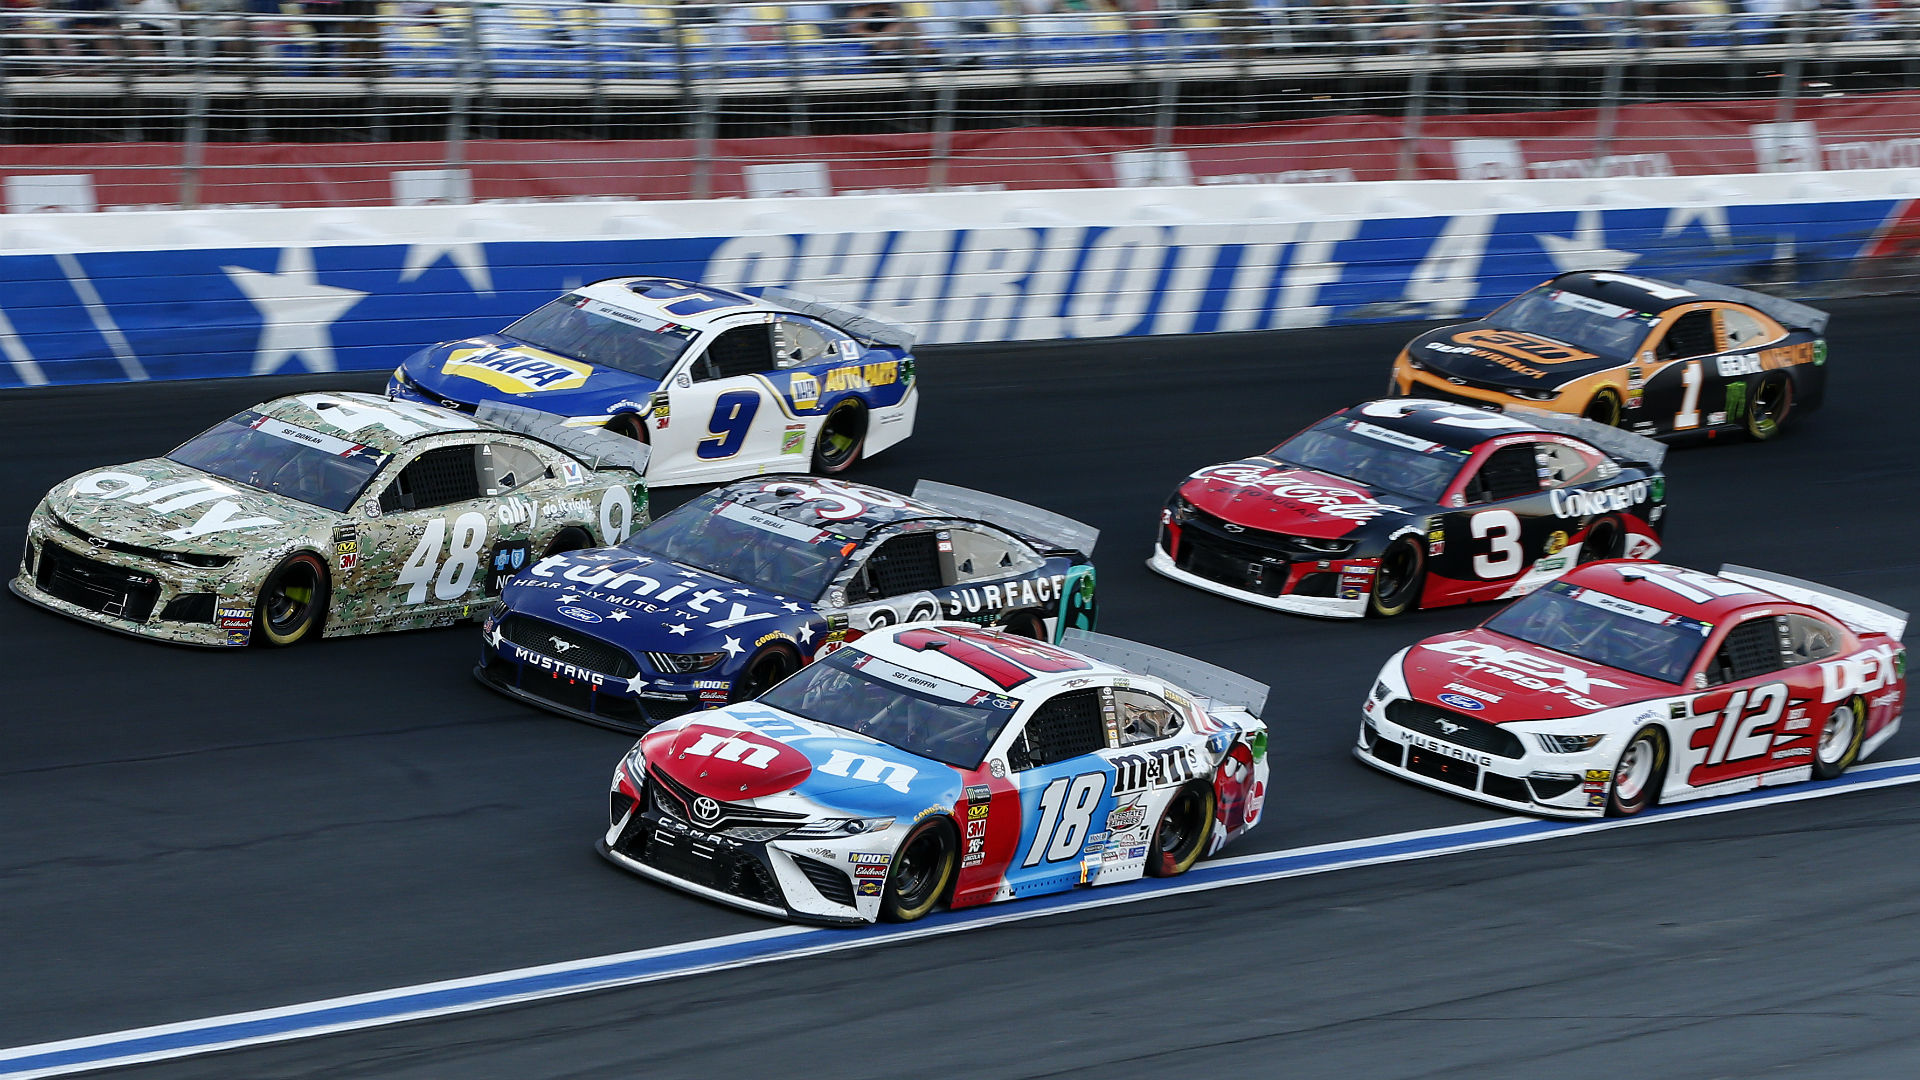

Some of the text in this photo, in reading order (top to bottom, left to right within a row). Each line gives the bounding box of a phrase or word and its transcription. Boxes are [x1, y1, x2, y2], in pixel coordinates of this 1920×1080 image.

[703, 216, 1499, 343] CHARLOTTE 4
[462, 350, 574, 387] NAPA
[825, 365, 862, 392] AUTO
[1674, 360, 1703, 431] 1
[281, 428, 322, 444] SGT DONLAN
[696, 388, 761, 461] 9
[498, 496, 538, 529] ally
[543, 502, 557, 515] do
[558, 498, 568, 511] it
[341, 553, 357, 569] 3M
[397, 511, 488, 605] 48
[1470, 509, 1524, 579] 3
[512, 579, 561, 590] HEAR
[673, 609, 699, 621] TV
[530, 554, 780, 629] tunity
[218, 608, 253, 618] MOOG
[754, 630, 797, 647] GOODYEAR
[515, 647, 605, 686] MUSTANG
[692, 680, 731, 689] MOOG
[892, 671, 938, 689] SGT GRIFFIN
[1420, 638, 1629, 695] DEX
[1819, 643, 1897, 704] DEX
[1164, 690, 1190, 708] STANLEY
[1705, 682, 1790, 768] 12
[683, 732, 781, 769] m
[1400, 730, 1493, 767] MUSTANG
[817, 748, 919, 794] m
[968, 821, 985, 837] 3M
[1022, 770, 1107, 869] 18
[1109, 809, 1143, 820] INTERSTATE
[850, 853, 890, 864] MOOG
[855, 866, 886, 878] Edelbrock
